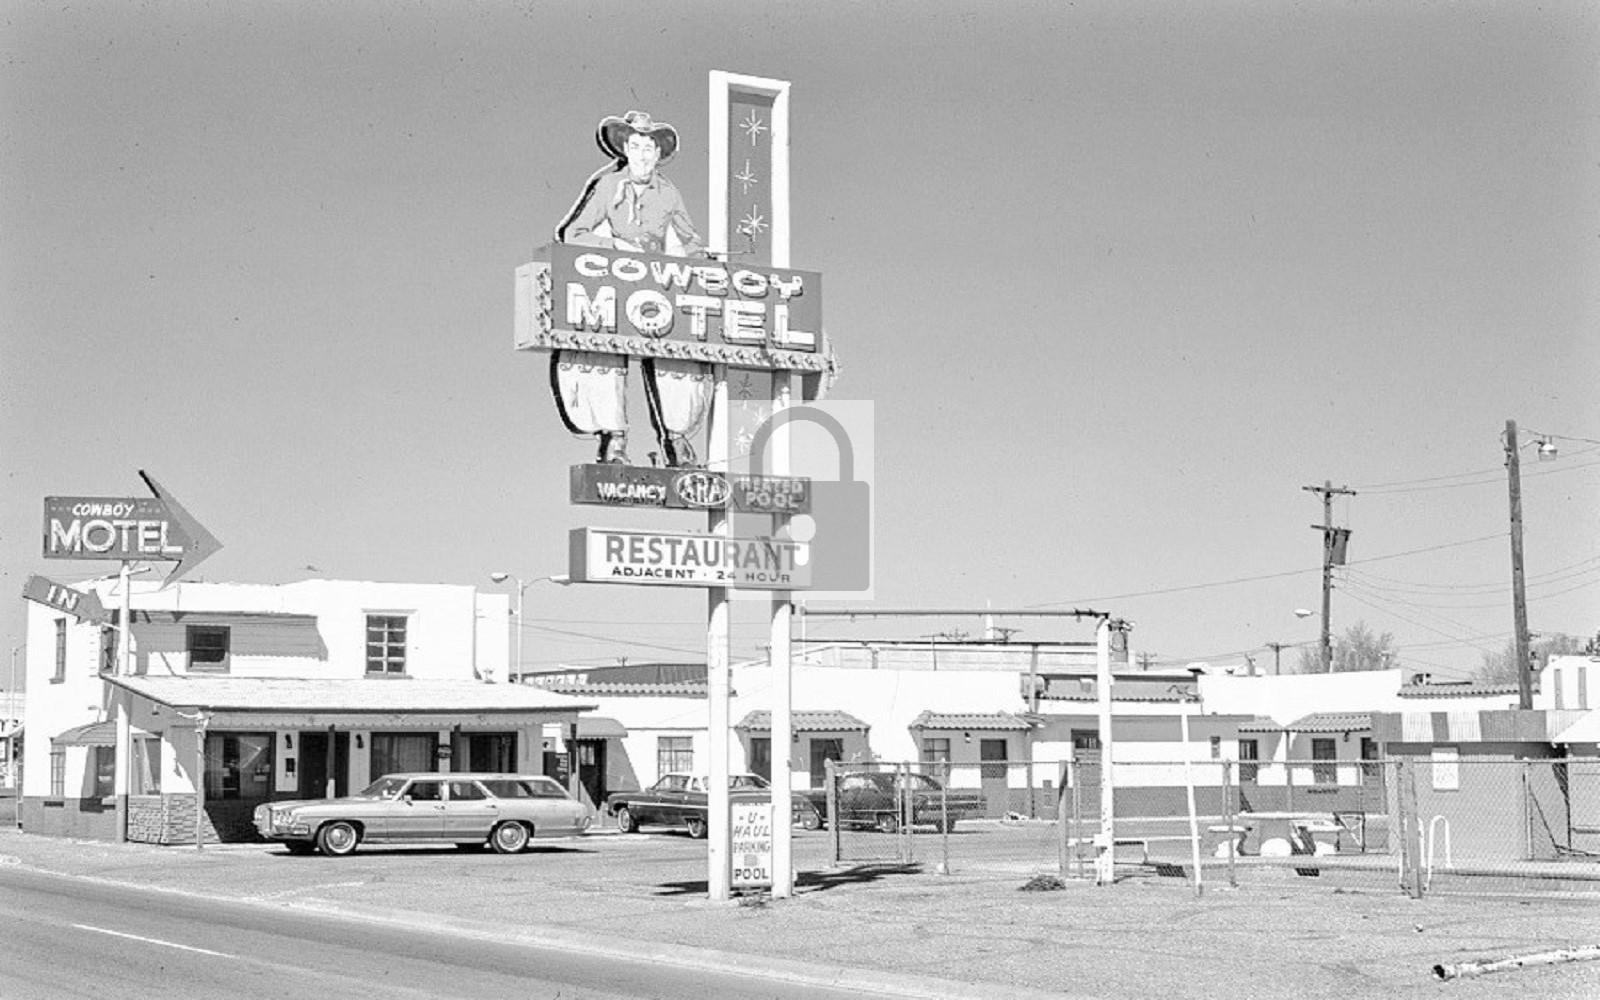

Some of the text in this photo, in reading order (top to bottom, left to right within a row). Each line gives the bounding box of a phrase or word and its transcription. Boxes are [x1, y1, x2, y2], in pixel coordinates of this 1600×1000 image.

[575, 254, 802, 299] COWBOY
[567, 282, 815, 349] MOTEL
[597, 482, 666, 500] VACANCY
[746, 492, 799, 508] POOL
[72, 503, 134, 517] COWBOY
[51, 518, 183, 553] MOTEL
[606, 535, 801, 571] RESTAURANT
[612, 566, 791, 583] ADJACENT 24 HOUR
[46, 585, 78, 609] IN
[733, 825, 771, 838] HAUL
[734, 868, 769, 880] POOL
